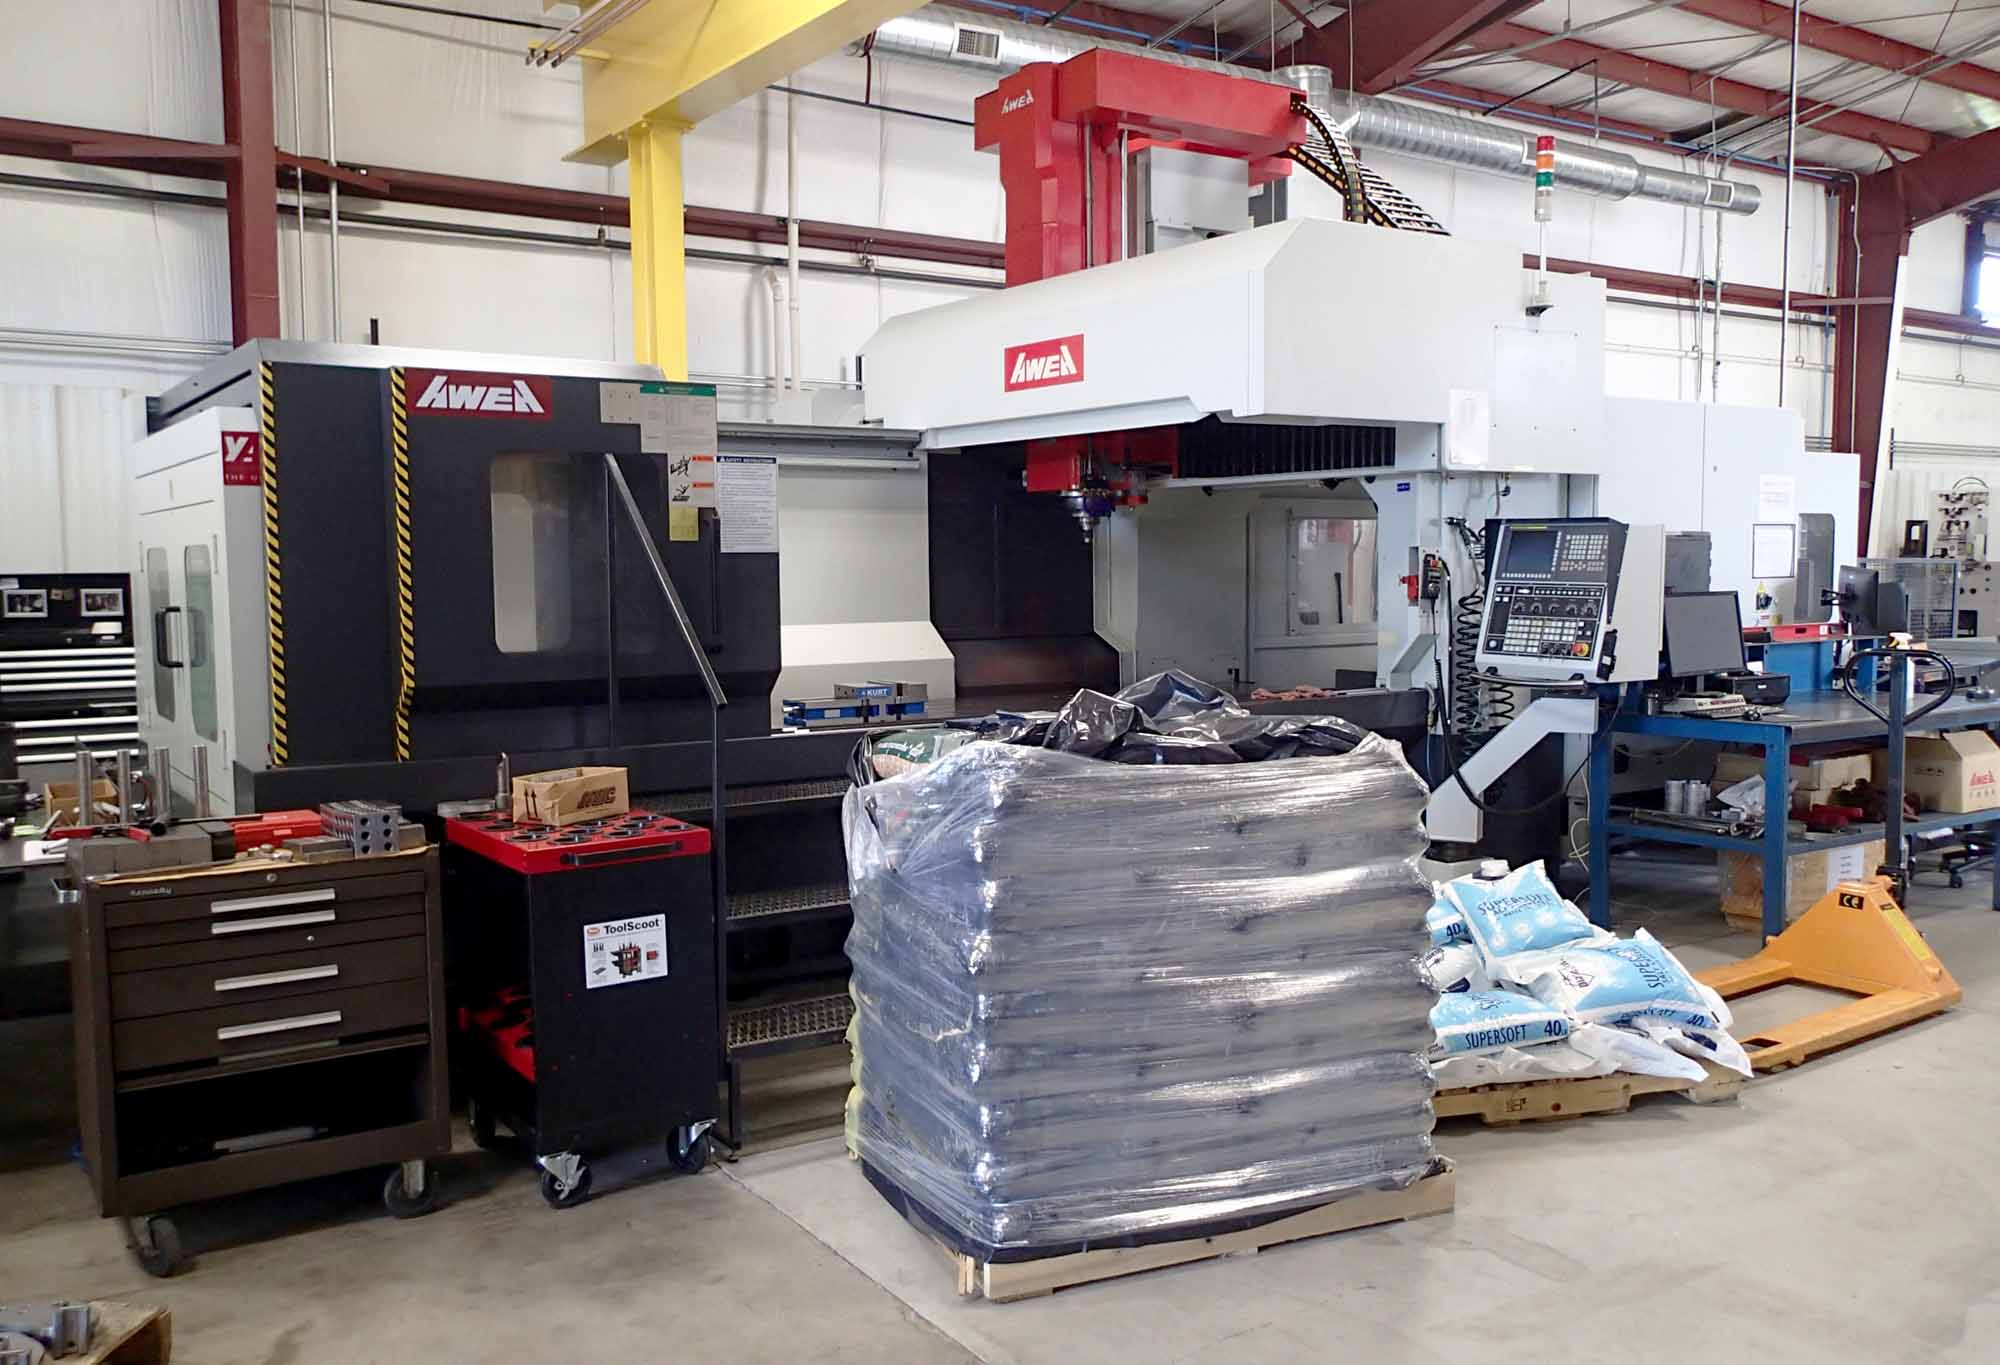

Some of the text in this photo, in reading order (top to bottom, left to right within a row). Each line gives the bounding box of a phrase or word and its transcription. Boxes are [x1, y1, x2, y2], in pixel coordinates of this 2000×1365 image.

[1001, 88, 1034, 114] AWEA
[1009, 345, 1078, 384] AWEA
[415, 375, 545, 413] AWEA
[867, 688, 888, 697] KURT
[604, 917, 660, 935] ToolScoot
[1446, 922, 1461, 937] 40
[1465, 1024, 1527, 1050] SUPERSOFT
[1543, 1019, 1562, 1037] 40
